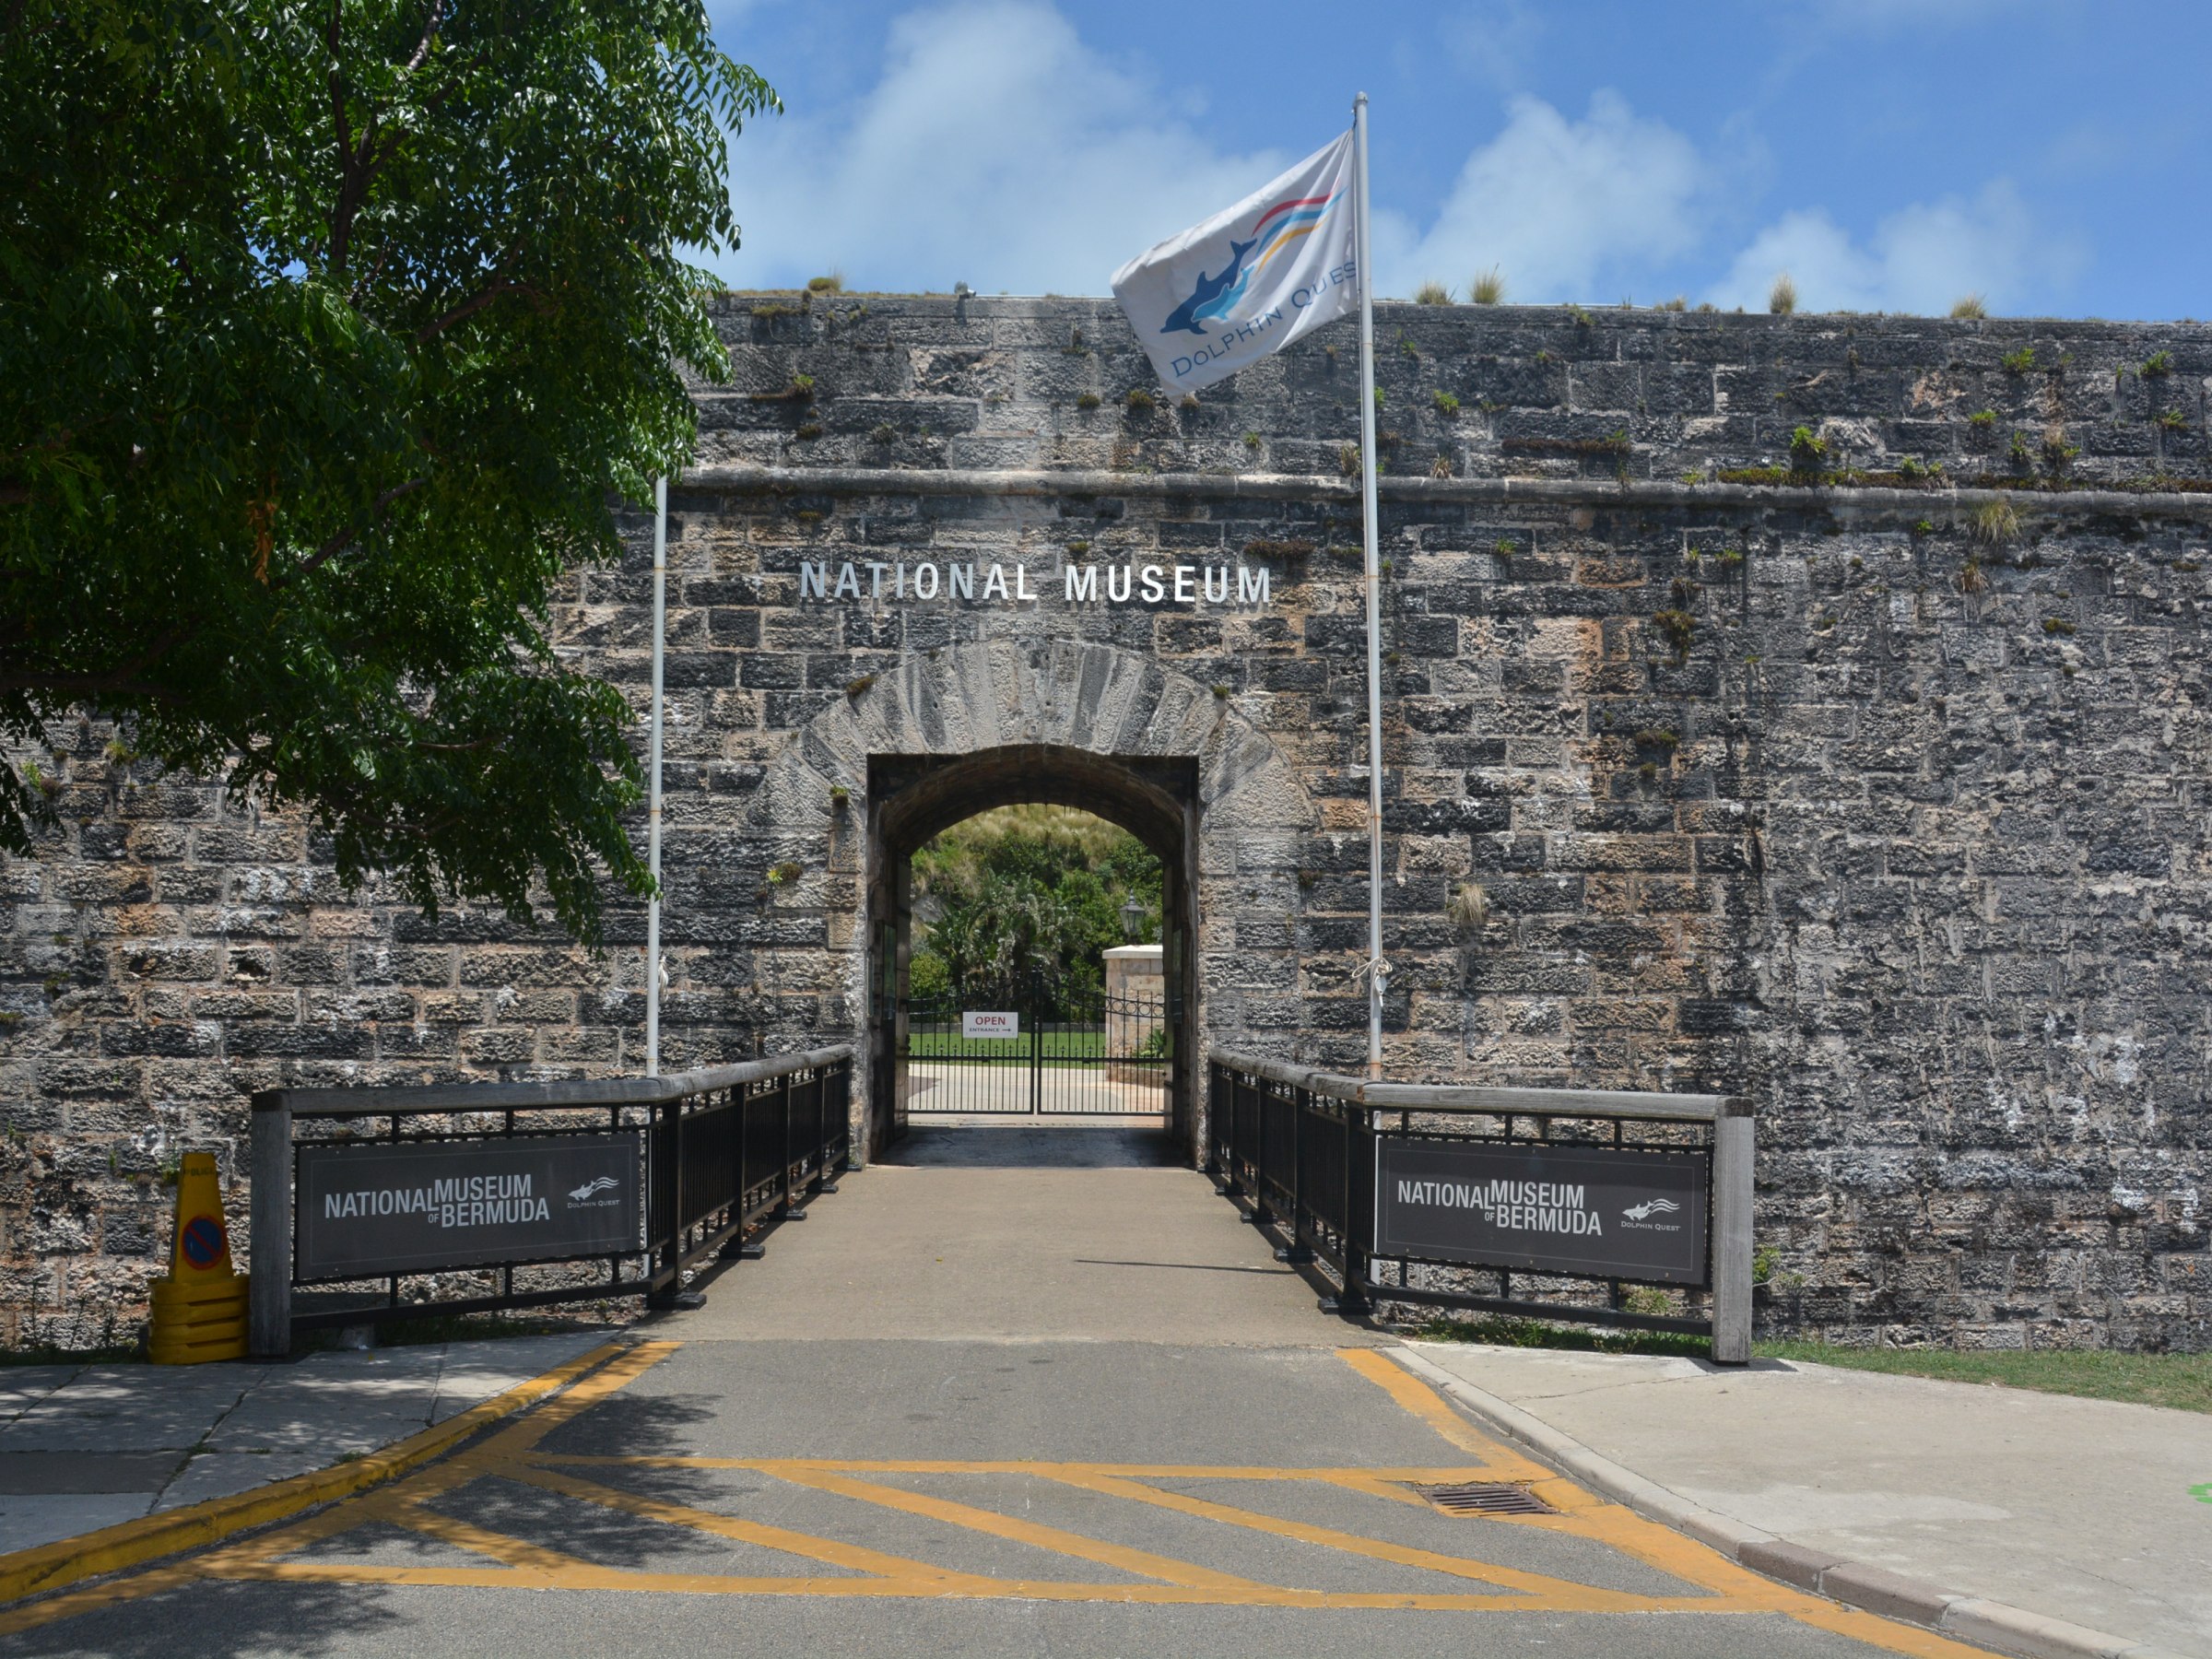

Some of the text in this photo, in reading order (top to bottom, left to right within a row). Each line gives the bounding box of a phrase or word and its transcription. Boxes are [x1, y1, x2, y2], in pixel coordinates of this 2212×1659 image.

[1171, 262, 1357, 377] DOLPHIN QUES
[800, 561, 1271, 603] NATIONAL MUSEUM
[975, 1016, 1006, 1026] OPEN
[324, 1173, 532, 1218] NATIONAL MUSEUM
[1398, 1179, 1584, 1210] NATIONAL MUSEUM
[428, 1197, 549, 1228] OF BERMUDA
[1484, 1205, 1603, 1236] OF BERMUDA
[1620, 1220, 1681, 1231] DOLPHIN QUEST
